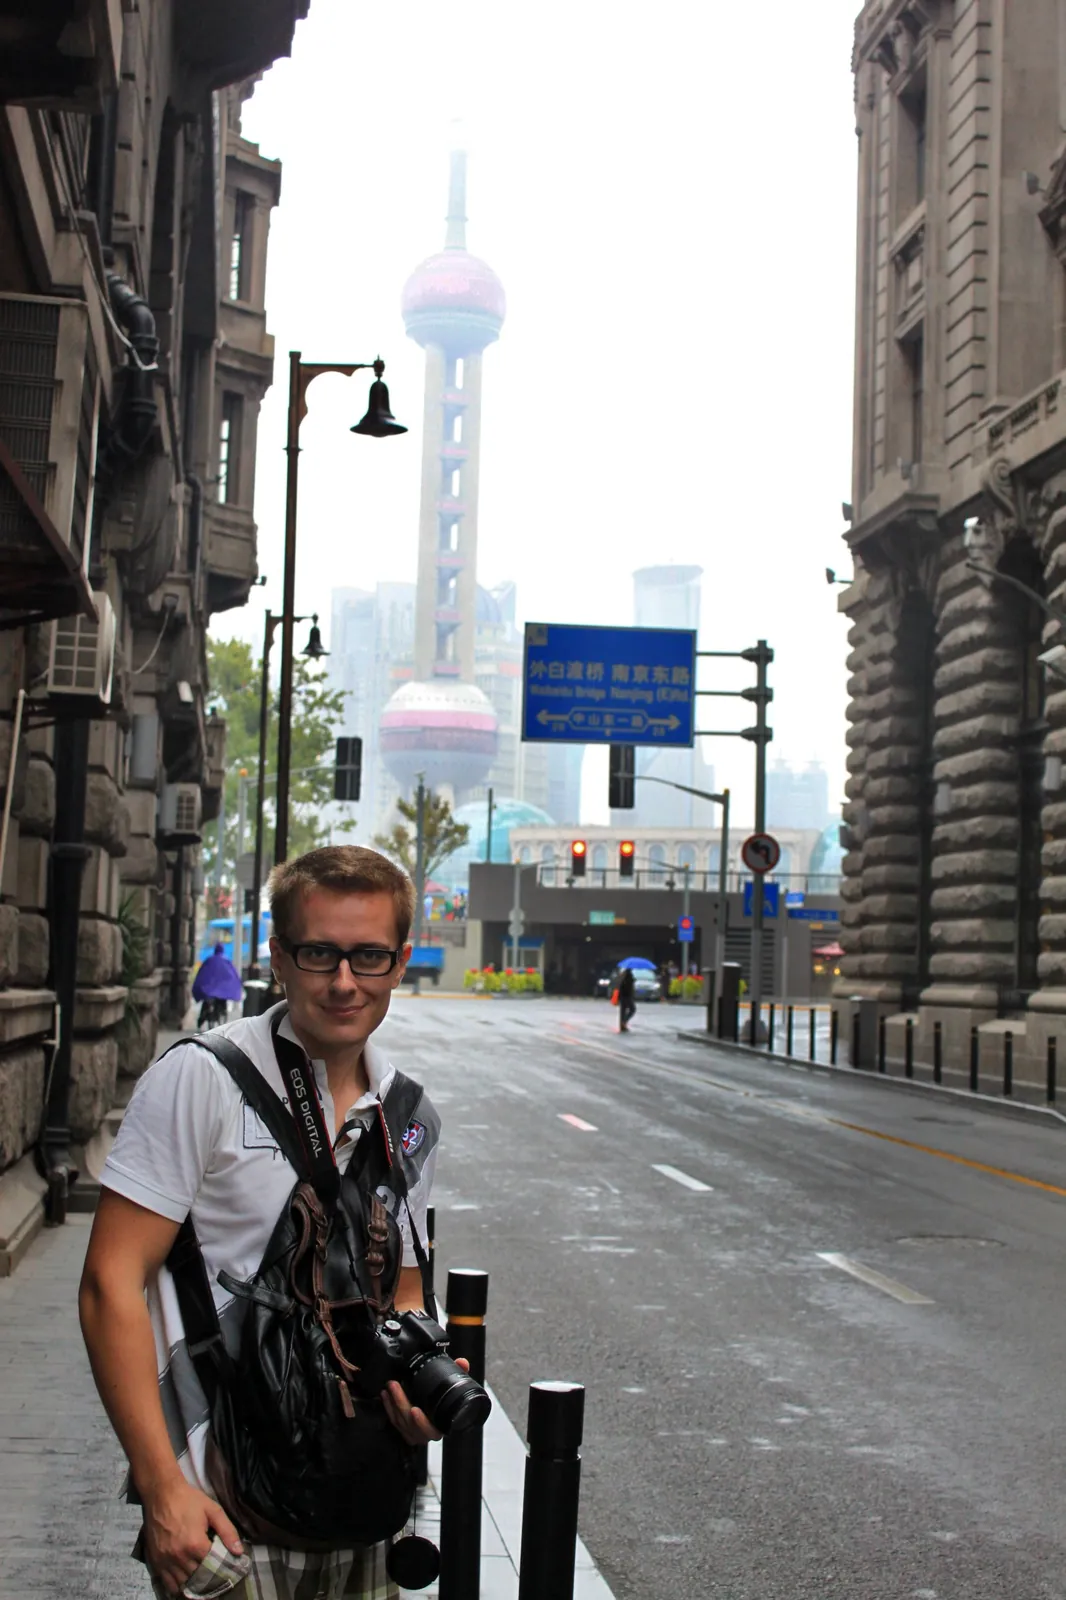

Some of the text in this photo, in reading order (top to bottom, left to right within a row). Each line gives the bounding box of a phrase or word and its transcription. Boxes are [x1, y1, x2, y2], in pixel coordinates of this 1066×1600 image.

[611, 664, 690, 685] 南京东路
[290, 1068, 322, 1158] EOS DIGITAL
